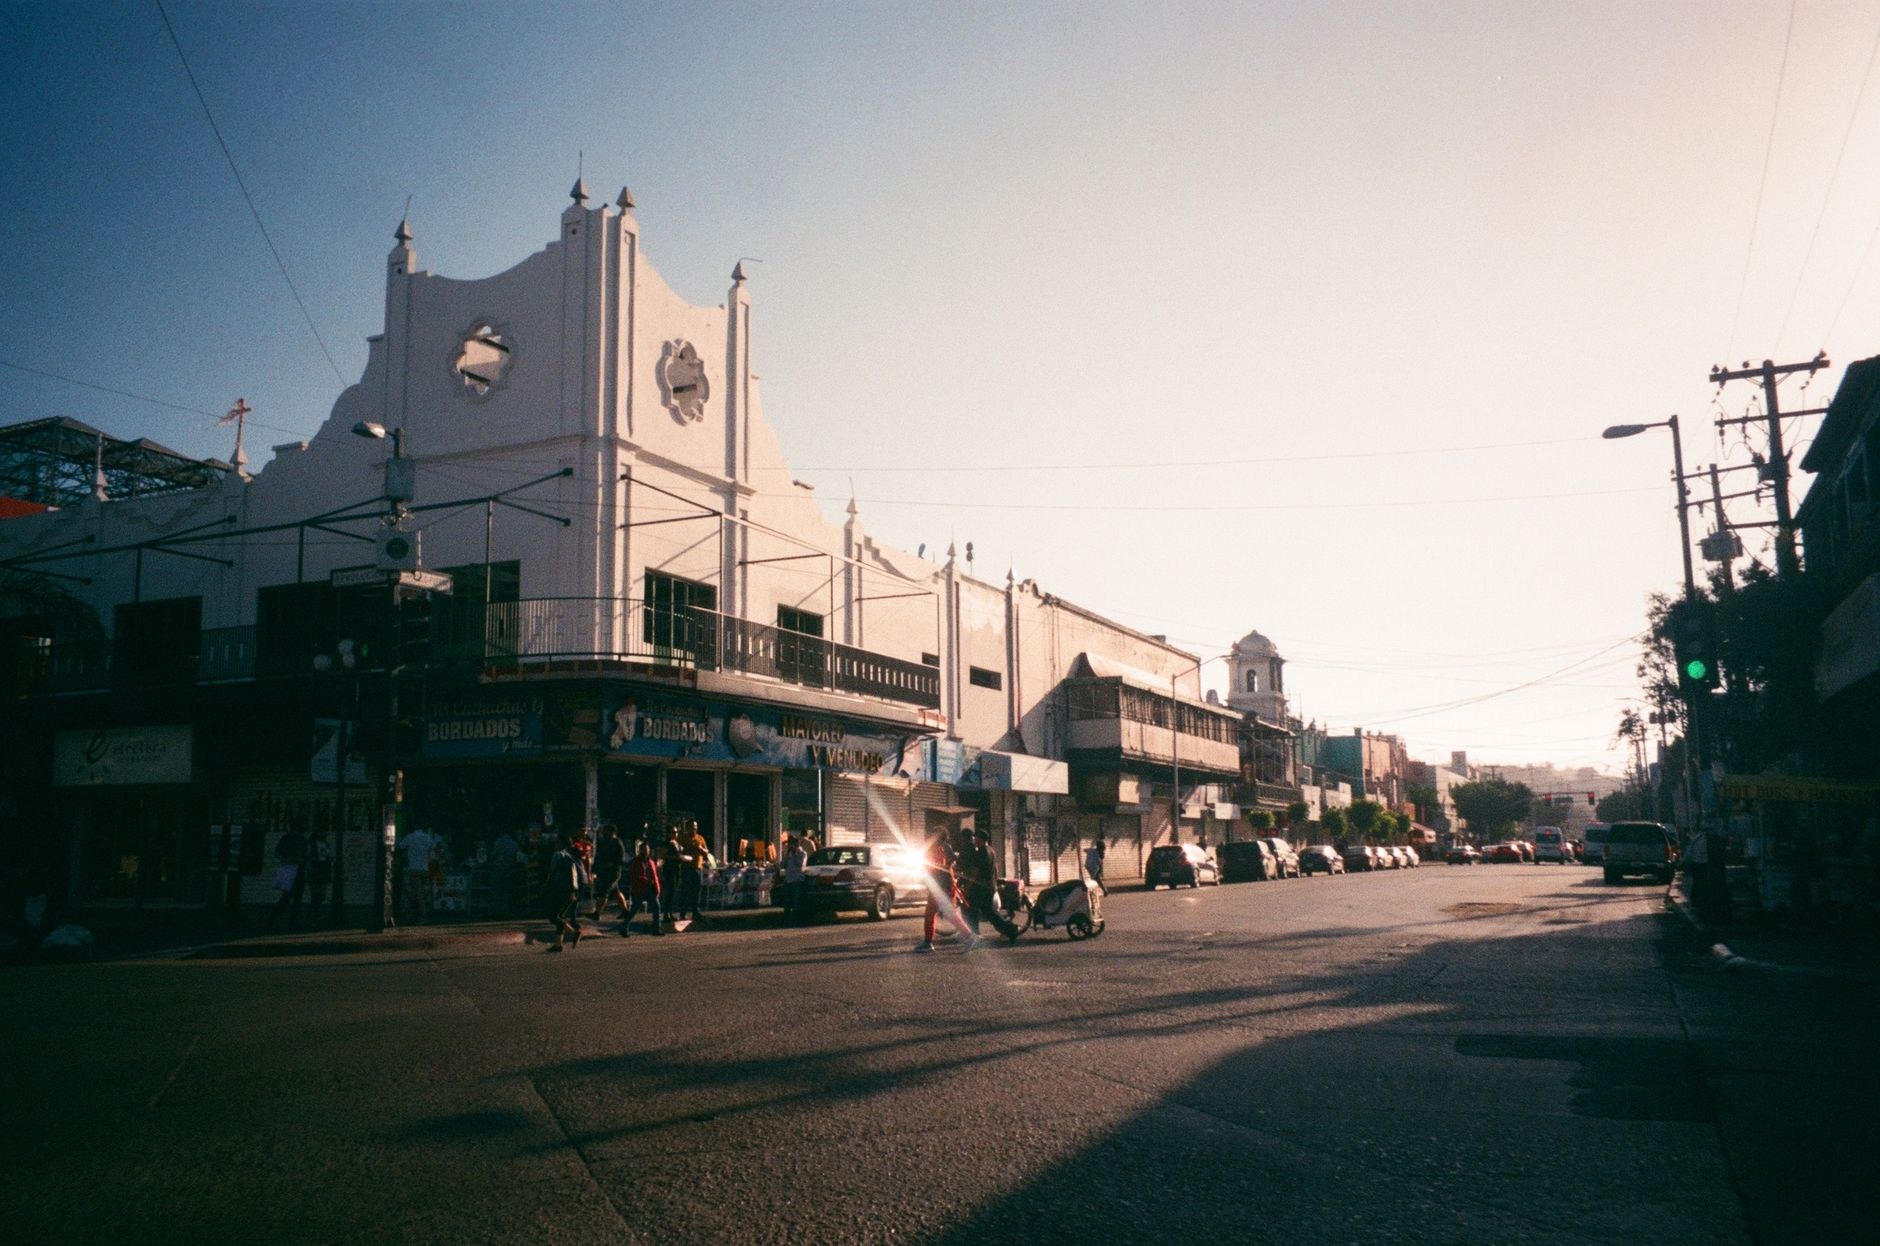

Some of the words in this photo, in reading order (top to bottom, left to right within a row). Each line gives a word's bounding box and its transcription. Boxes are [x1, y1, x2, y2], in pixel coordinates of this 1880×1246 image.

[428, 717, 521, 741] BORDADOS
[643, 717, 714, 743] BORDADOS
[783, 715, 845, 743] MAYOREO
[826, 746, 884, 774] MENUDEO
